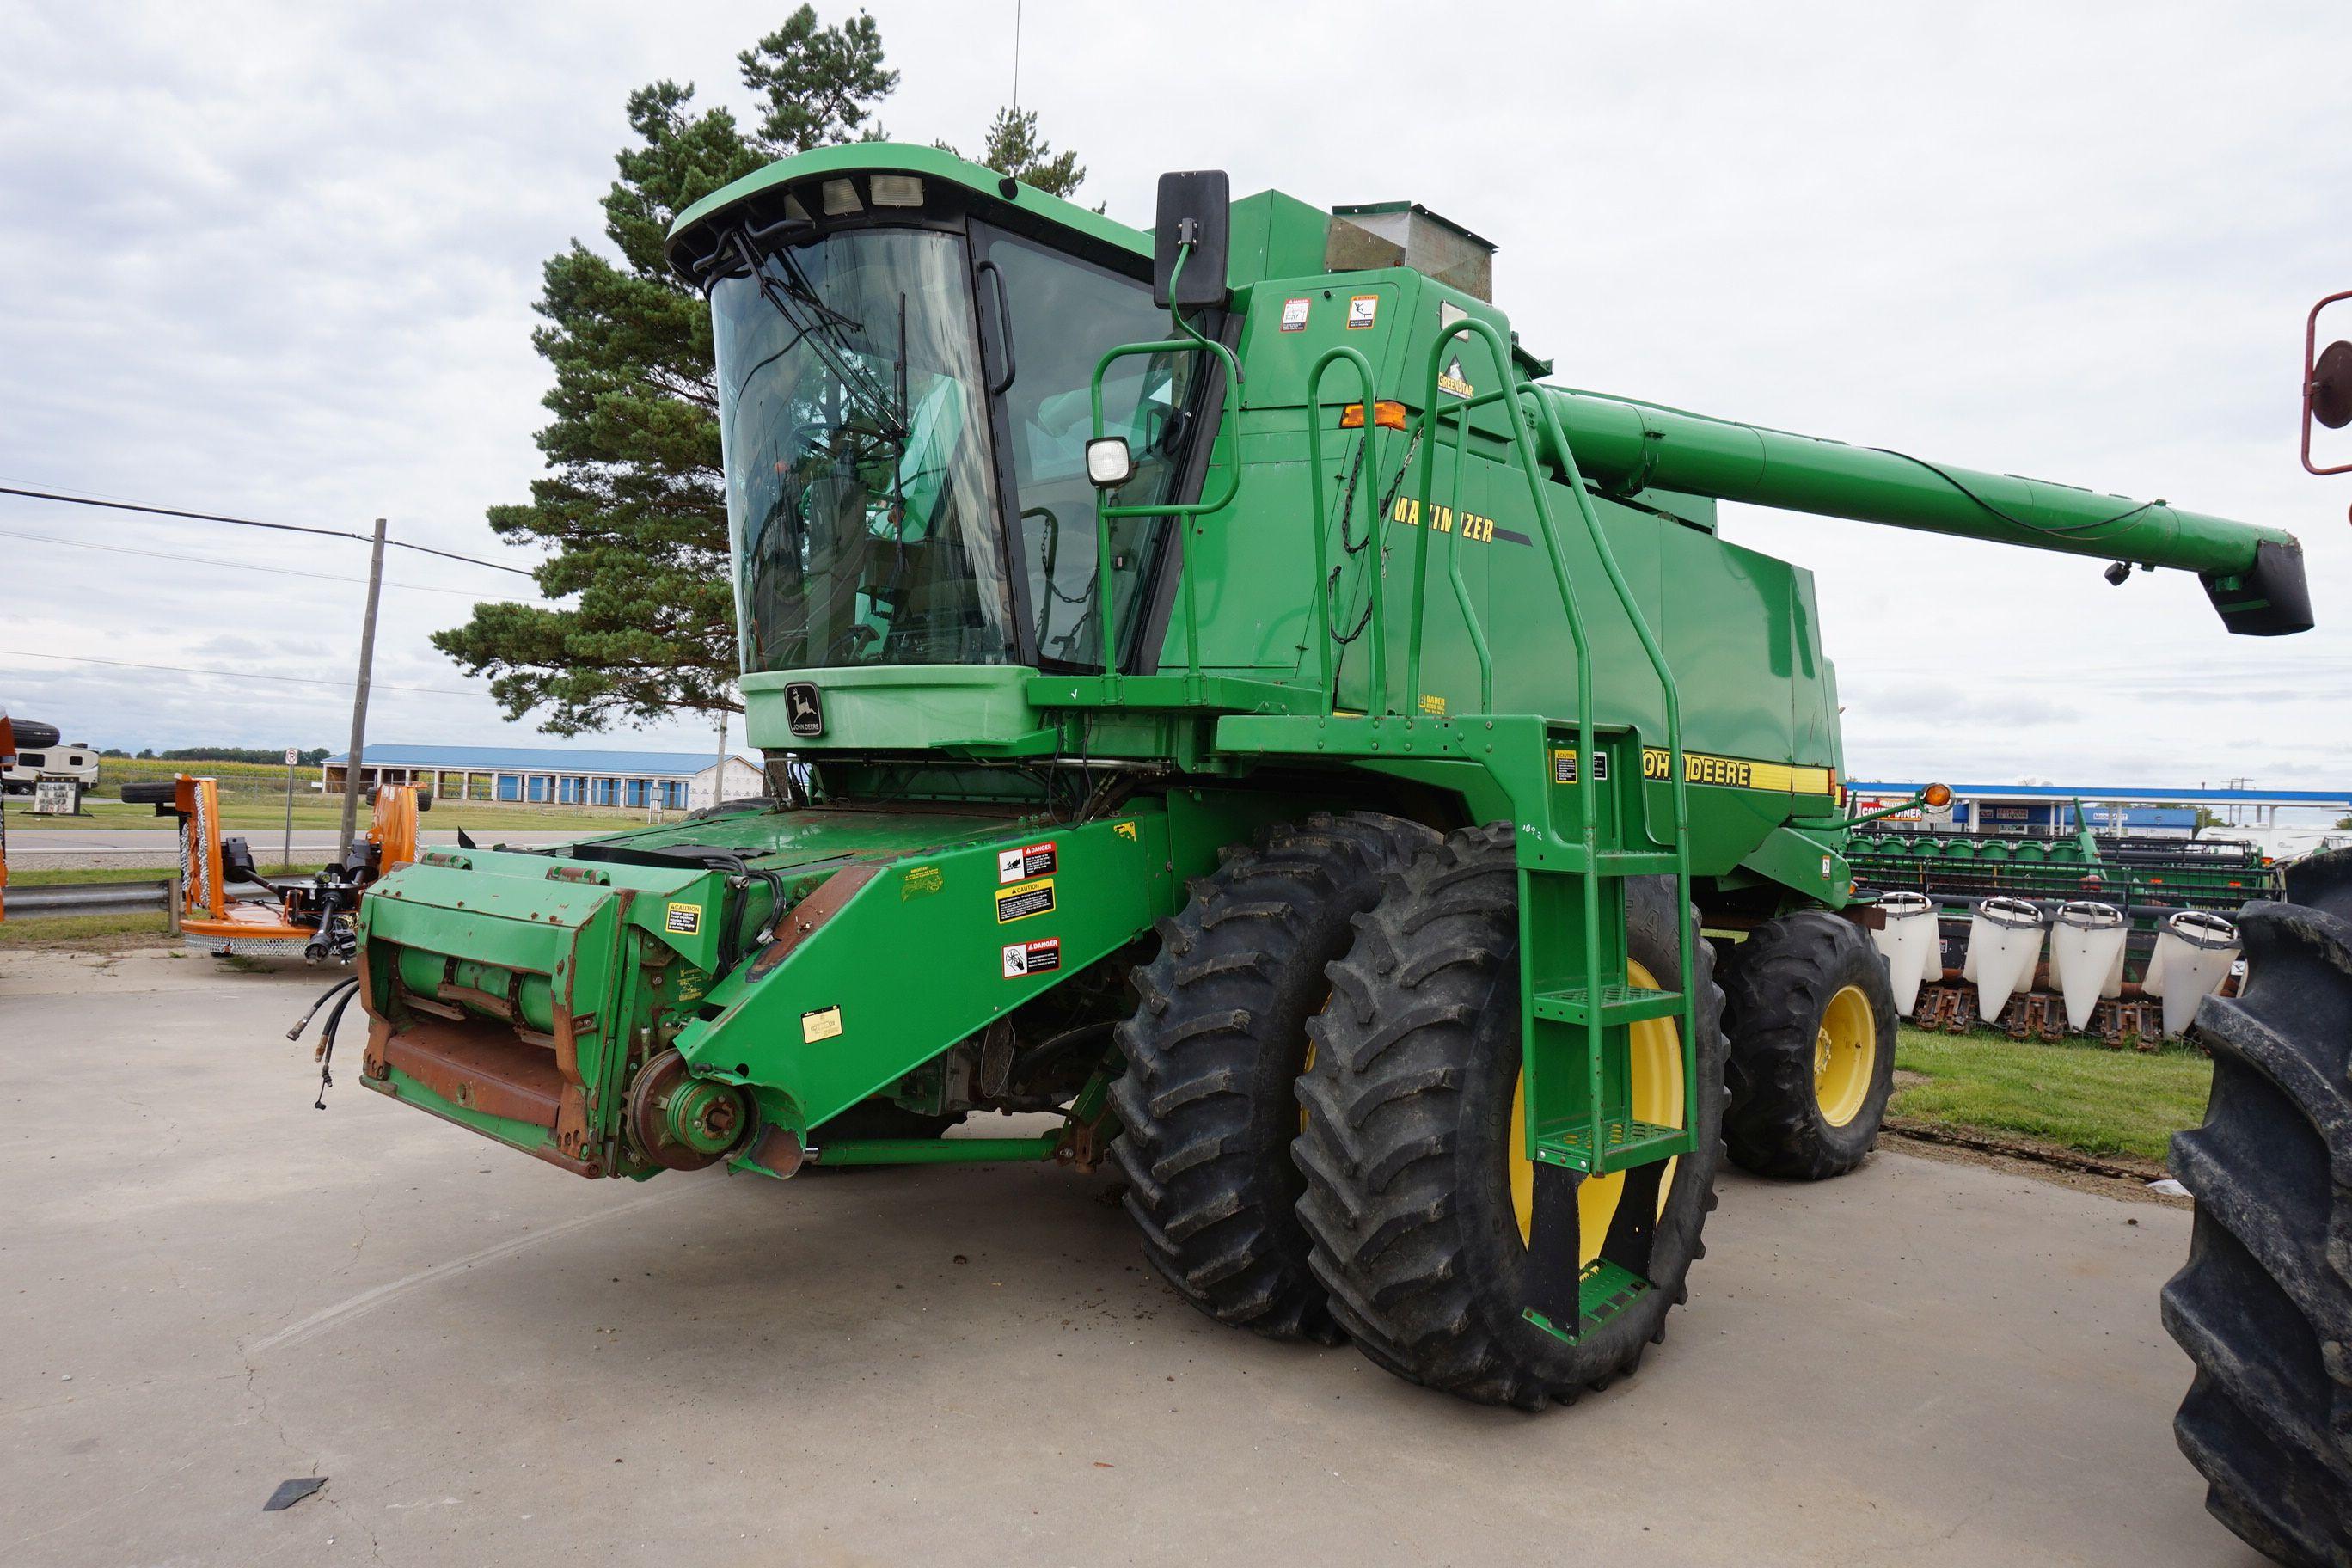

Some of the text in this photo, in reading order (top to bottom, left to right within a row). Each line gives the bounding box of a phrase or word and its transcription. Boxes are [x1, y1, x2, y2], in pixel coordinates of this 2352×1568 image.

[1393, 496, 1495, 543] MAIMZER
[1643, 752, 1750, 786] OH DEERE
[1031, 844, 1052, 854] DANGER
[1016, 884, 1039, 893] CAUTION
[675, 903, 700, 912] CAUTION
[1033, 940, 1057, 950] DANGER
